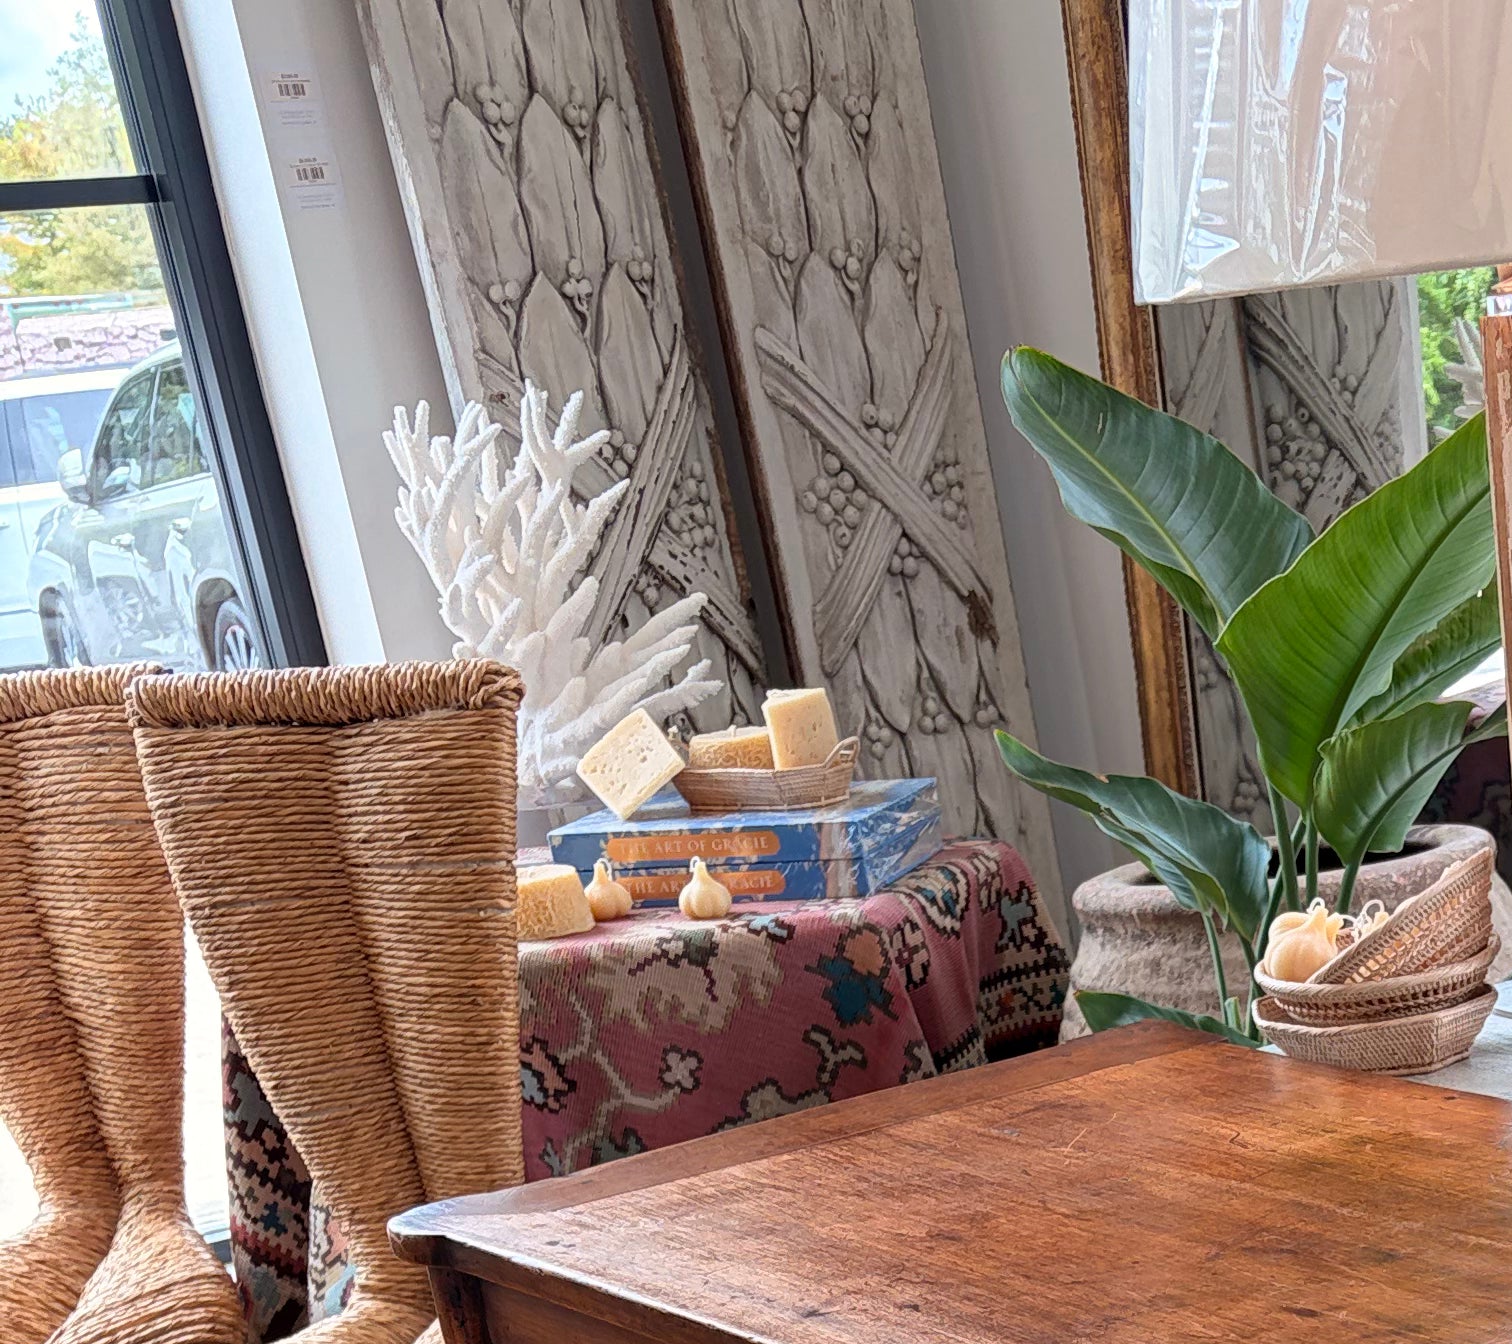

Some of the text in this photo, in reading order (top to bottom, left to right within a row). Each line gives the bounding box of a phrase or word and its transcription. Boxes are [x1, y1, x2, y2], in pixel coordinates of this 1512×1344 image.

[620, 836, 769, 855] THE ART OF GRACIE
[722, 875, 774, 889] RACIE
